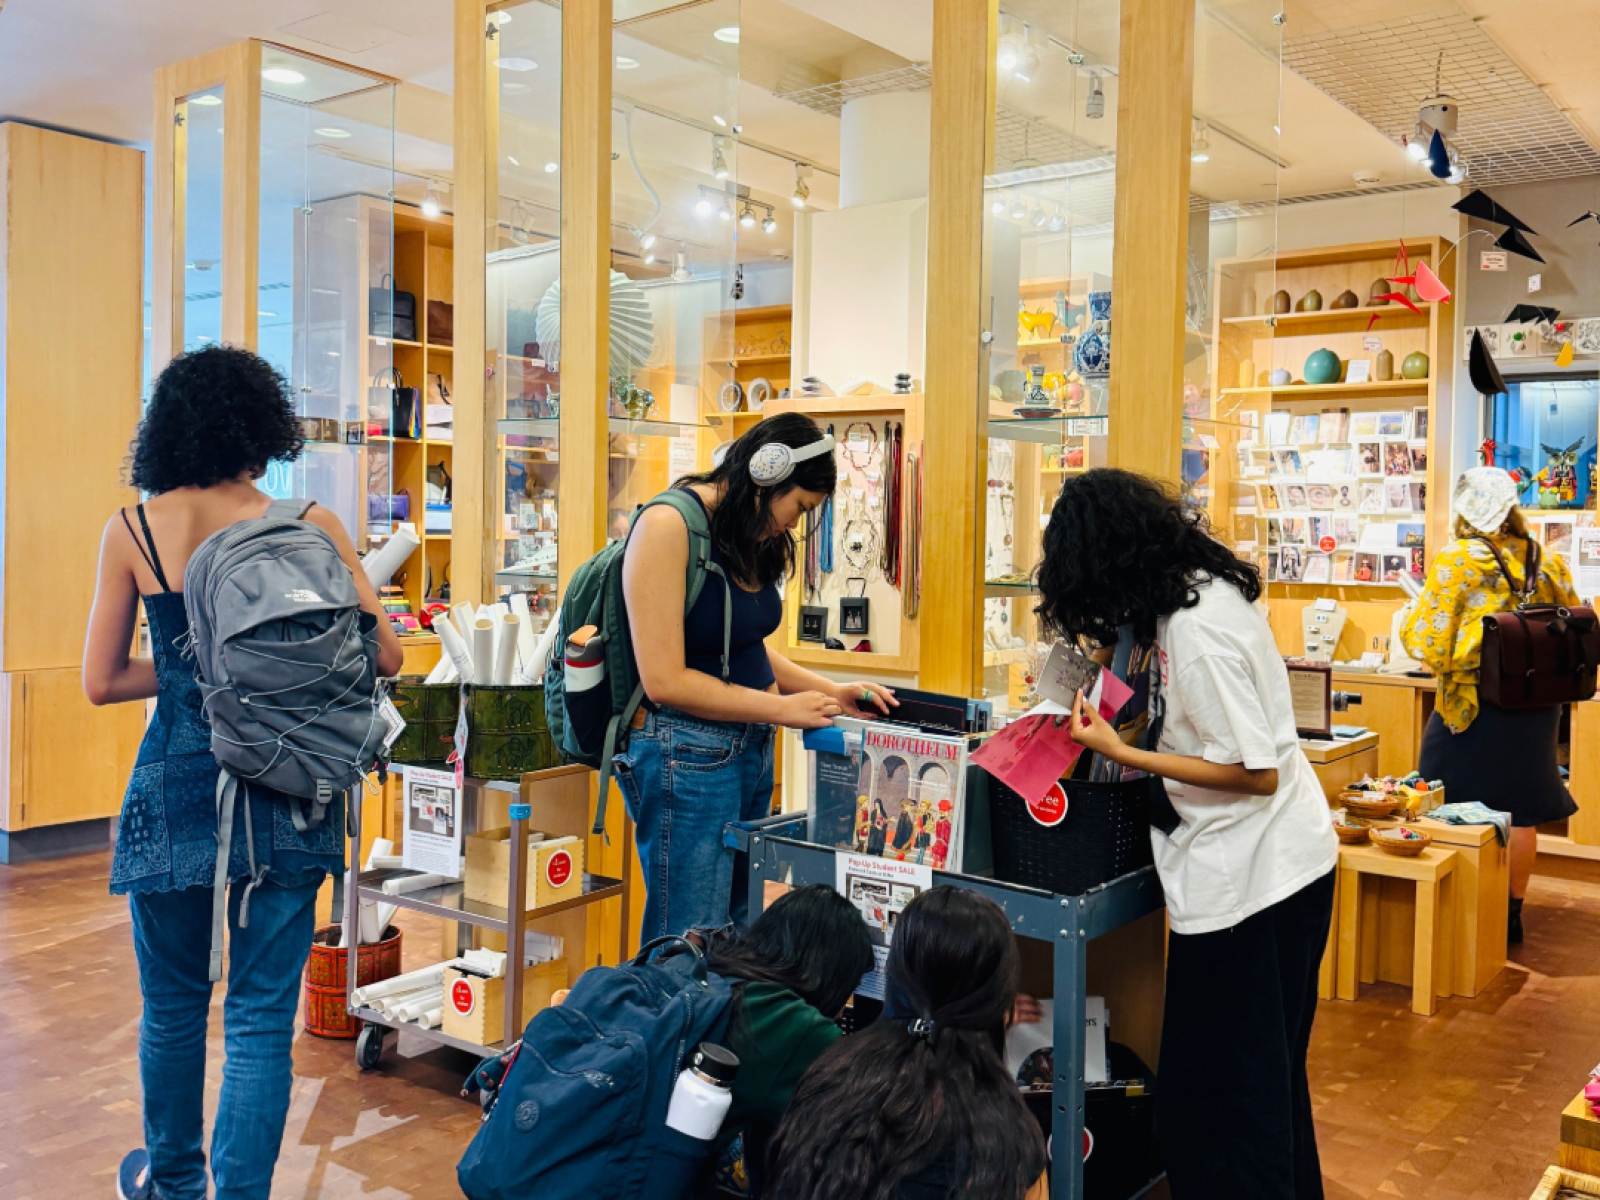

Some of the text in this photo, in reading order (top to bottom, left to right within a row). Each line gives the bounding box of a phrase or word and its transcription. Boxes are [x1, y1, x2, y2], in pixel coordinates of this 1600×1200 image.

[866, 731, 957, 760] DOROTHEUM
[872, 861, 897, 872] Student
[899, 866, 915, 876] SALE
